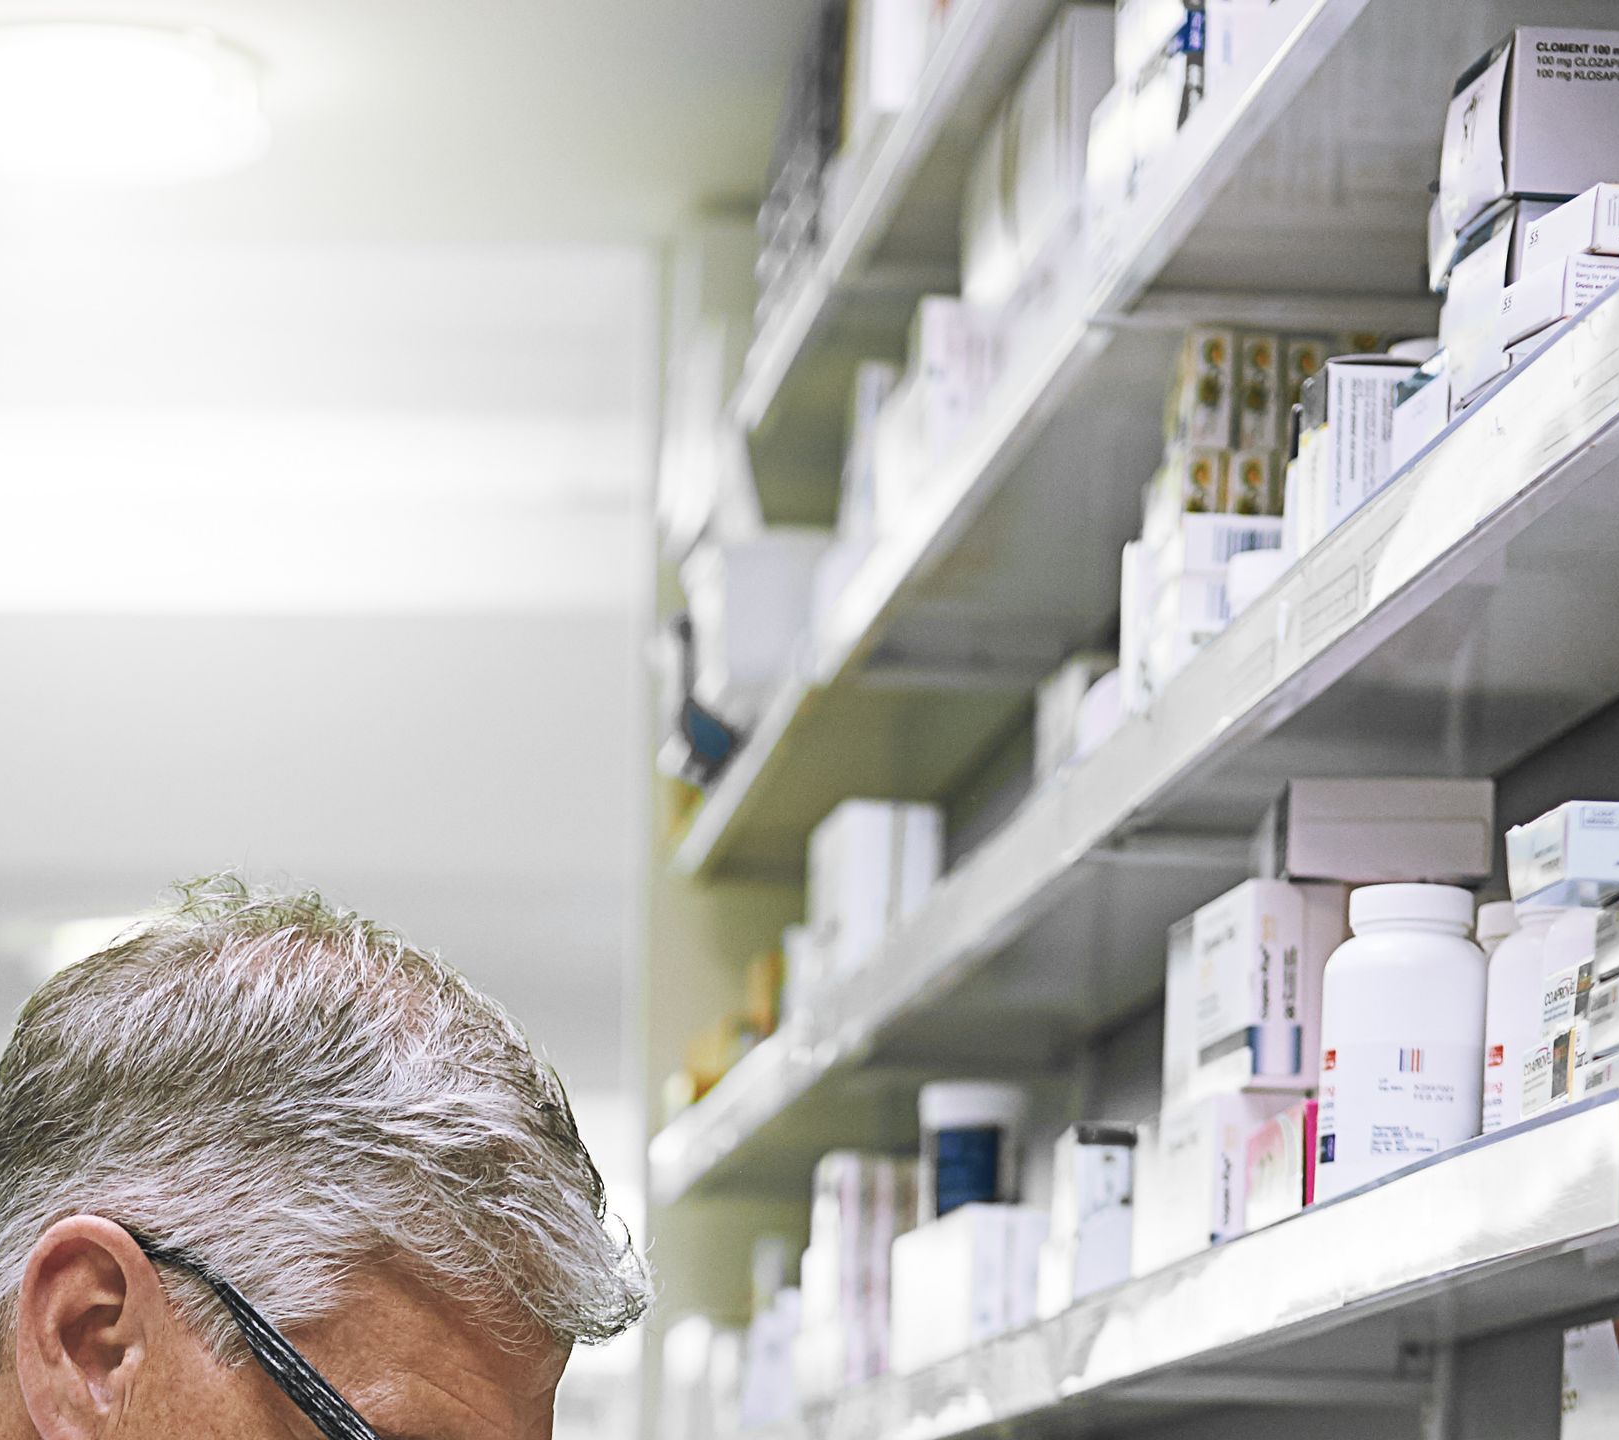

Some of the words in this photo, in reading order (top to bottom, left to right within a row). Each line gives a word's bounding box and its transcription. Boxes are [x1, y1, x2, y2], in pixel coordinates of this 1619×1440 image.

[1536, 41, 1589, 55] CLOMENT
[1592, 42, 1611, 55] 100
[1536, 55, 1554, 67] 100
[1556, 57, 1572, 68] mg
[1536, 69, 1554, 80] 100
[1556, 70, 1572, 82] mg
